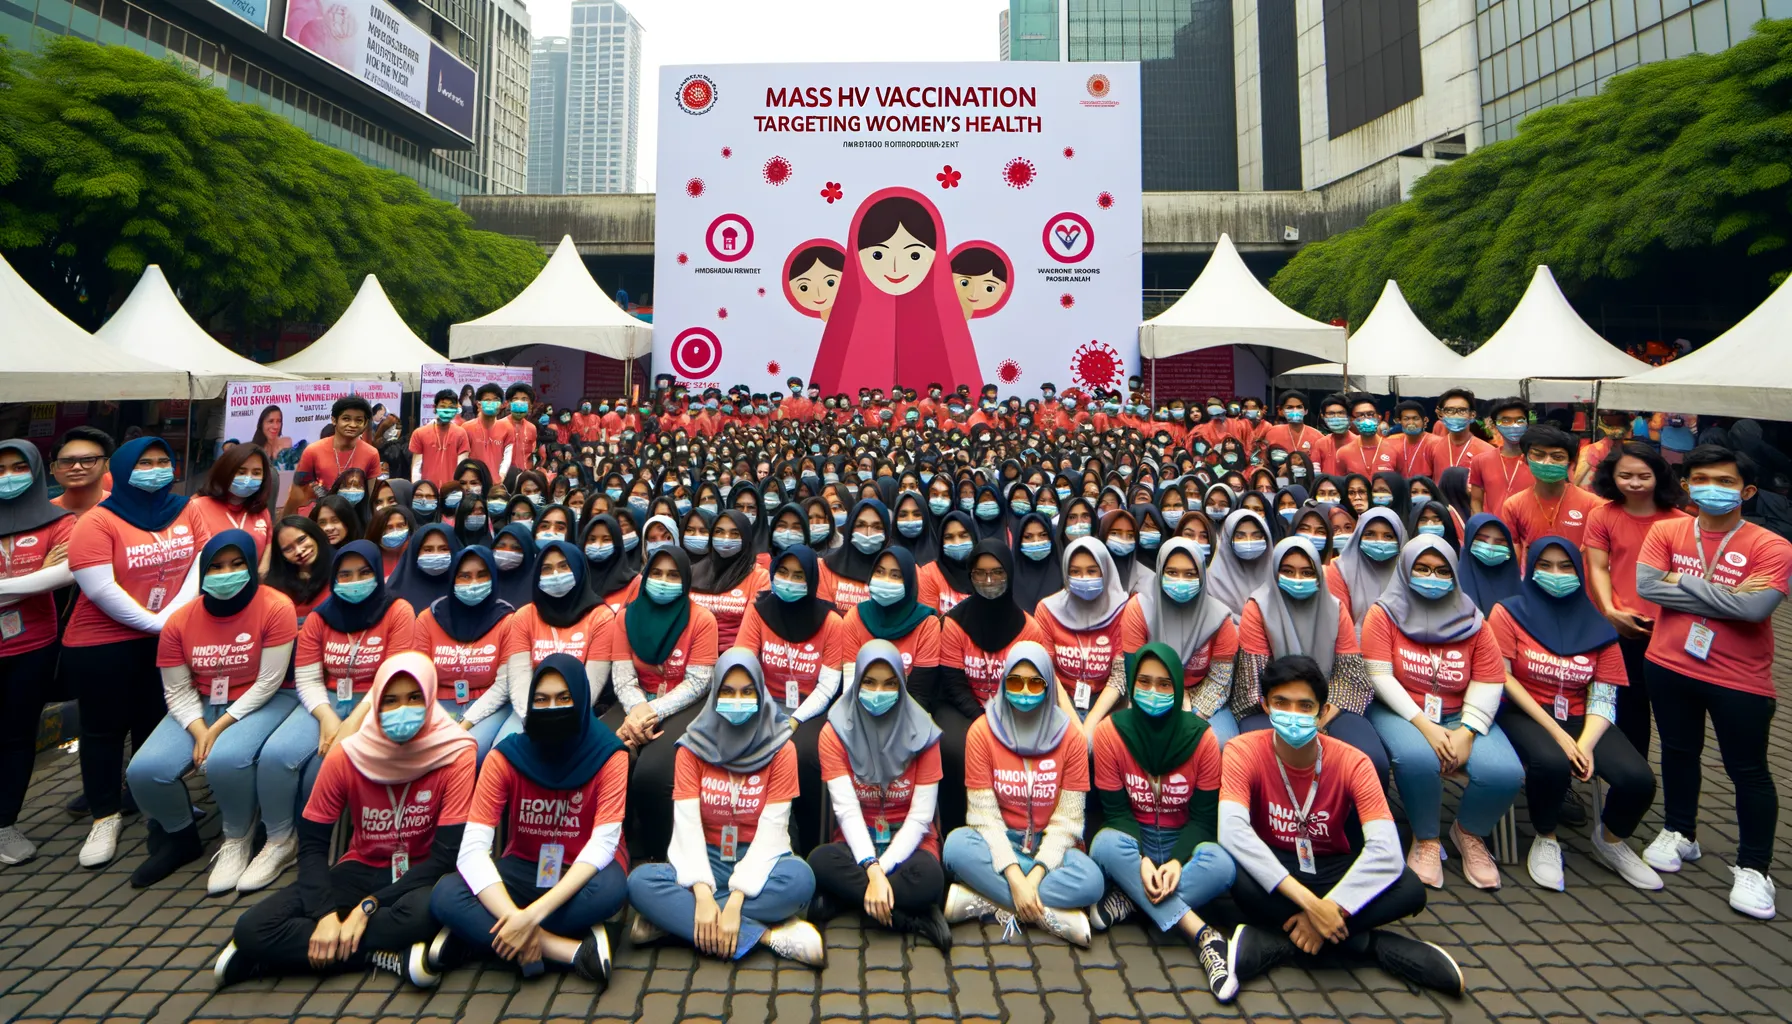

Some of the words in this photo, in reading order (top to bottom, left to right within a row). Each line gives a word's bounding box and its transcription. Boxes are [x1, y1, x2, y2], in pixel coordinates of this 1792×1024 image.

[766, 86, 833, 108] MASS
[838, 86, 870, 108] HV
[875, 86, 1037, 108] VACCINATION
[754, 115, 861, 132] TARGETING
[865, 115, 961, 132] WOMEN'S
[965, 115, 1042, 133] HEALTH
